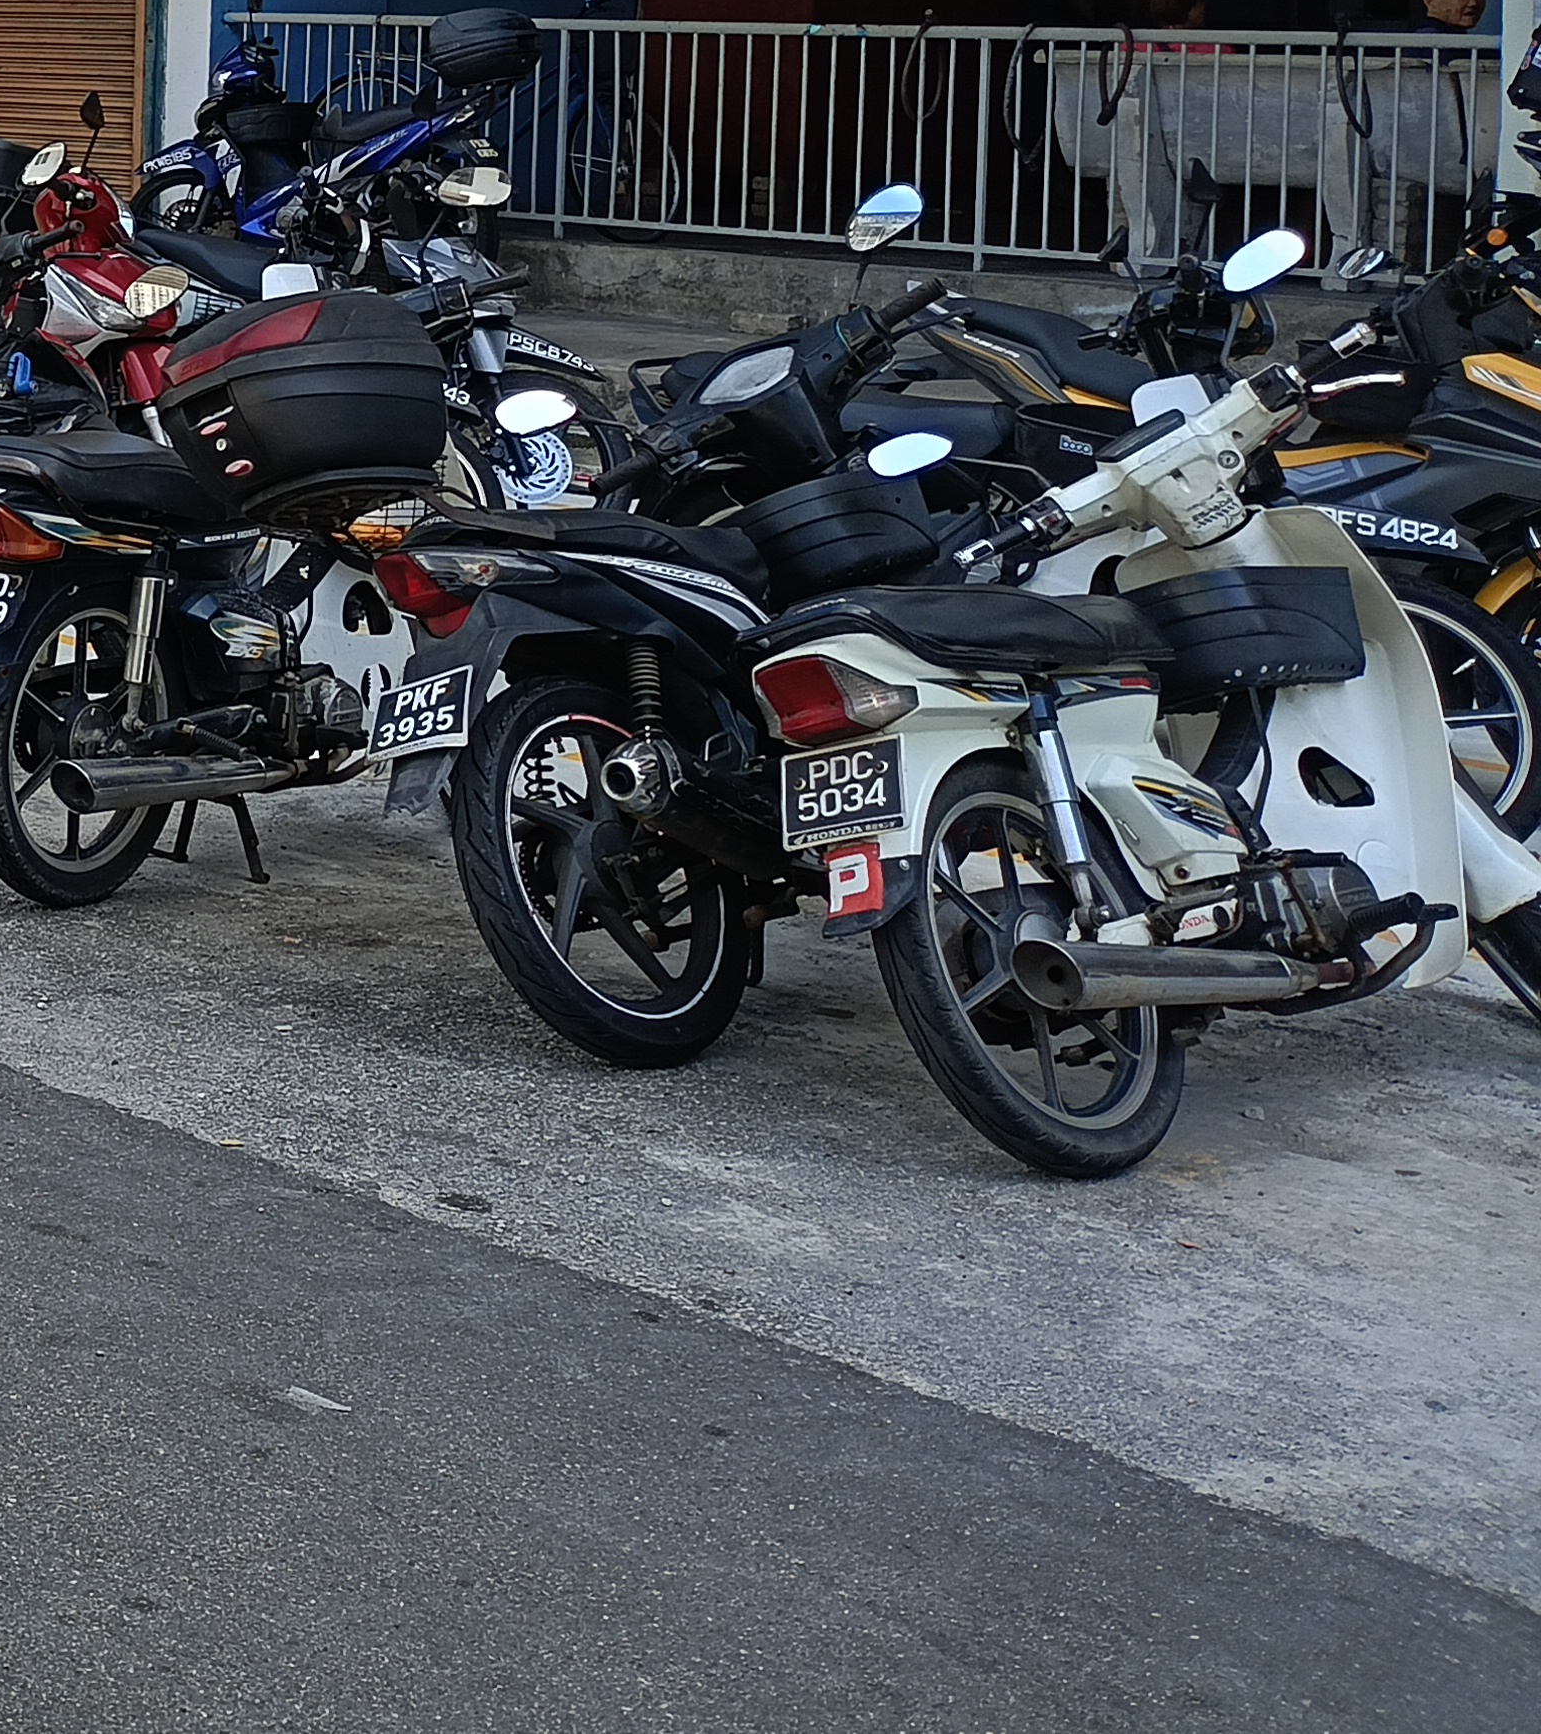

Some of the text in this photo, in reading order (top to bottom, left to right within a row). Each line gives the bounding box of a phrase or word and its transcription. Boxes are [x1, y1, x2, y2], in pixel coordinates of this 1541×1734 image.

[143, 147, 192, 173] PKW6185
[1380, 516, 1458, 550] 4824
[394, 677, 451, 717] PKF
[377, 704, 456, 747] 3935
[808, 751, 874, 790] PDC
[798, 777, 886, 822] 5034
[806, 825, 863, 844] HONDA
[829, 853, 869, 913] P
